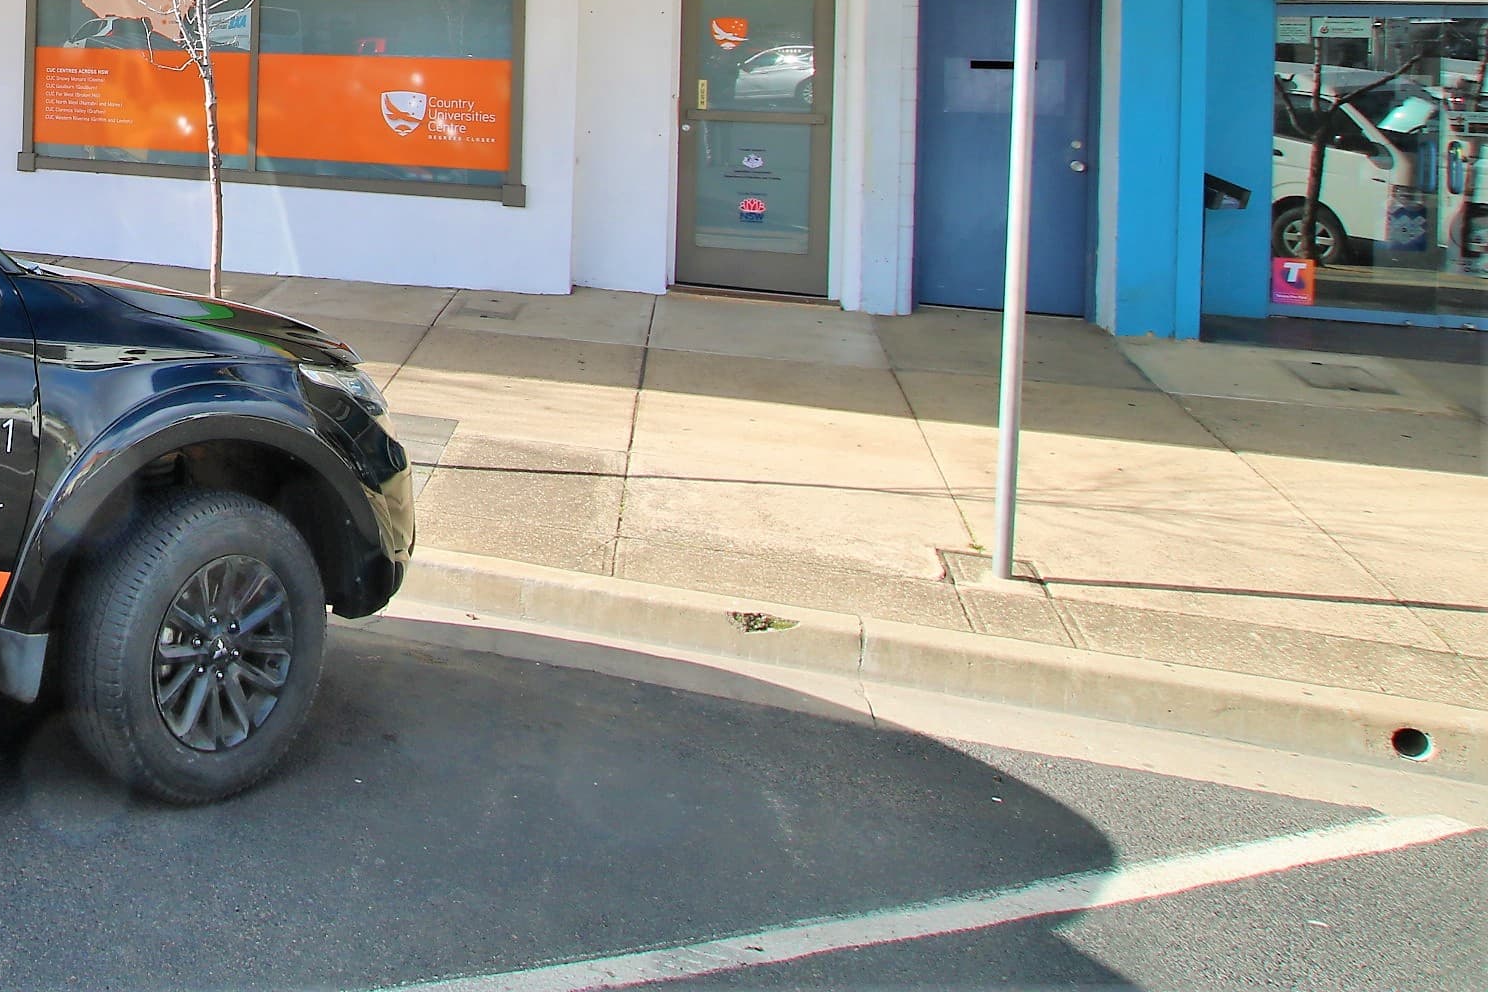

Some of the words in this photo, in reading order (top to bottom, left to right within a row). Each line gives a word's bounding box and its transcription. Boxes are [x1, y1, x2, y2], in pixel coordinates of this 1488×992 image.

[428, 96, 474, 110] Country
[428, 108, 496, 123] Universities
[427, 120, 467, 134] Centre
